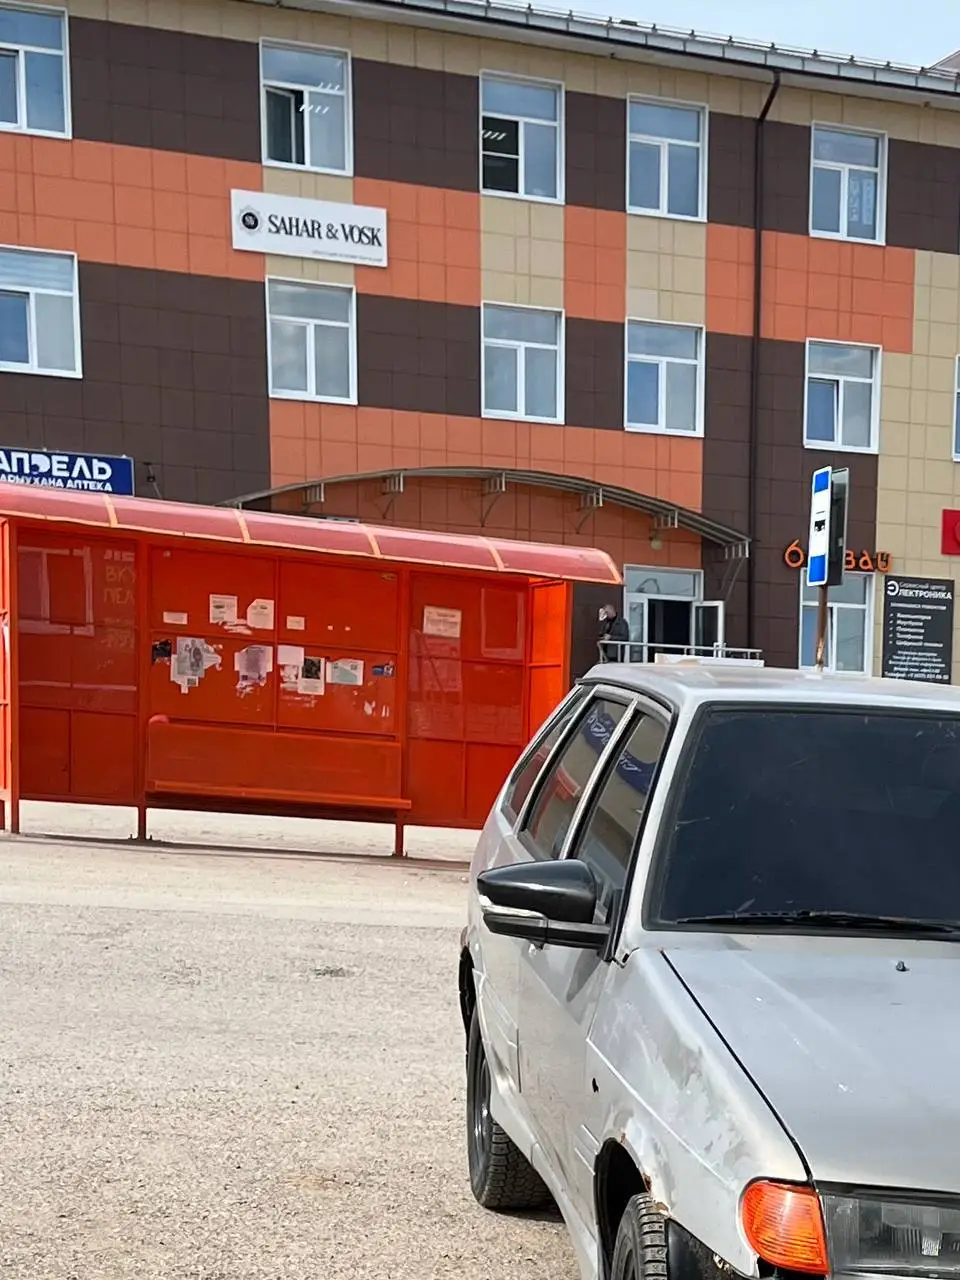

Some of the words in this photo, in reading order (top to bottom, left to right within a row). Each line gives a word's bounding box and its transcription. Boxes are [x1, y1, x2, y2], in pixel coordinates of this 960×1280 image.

[268, 214, 322, 239] SAHAR
[326, 222, 339, 240] &
[341, 223, 382, 247] VOSK
[66, 479, 113, 492] АПТЕКА
